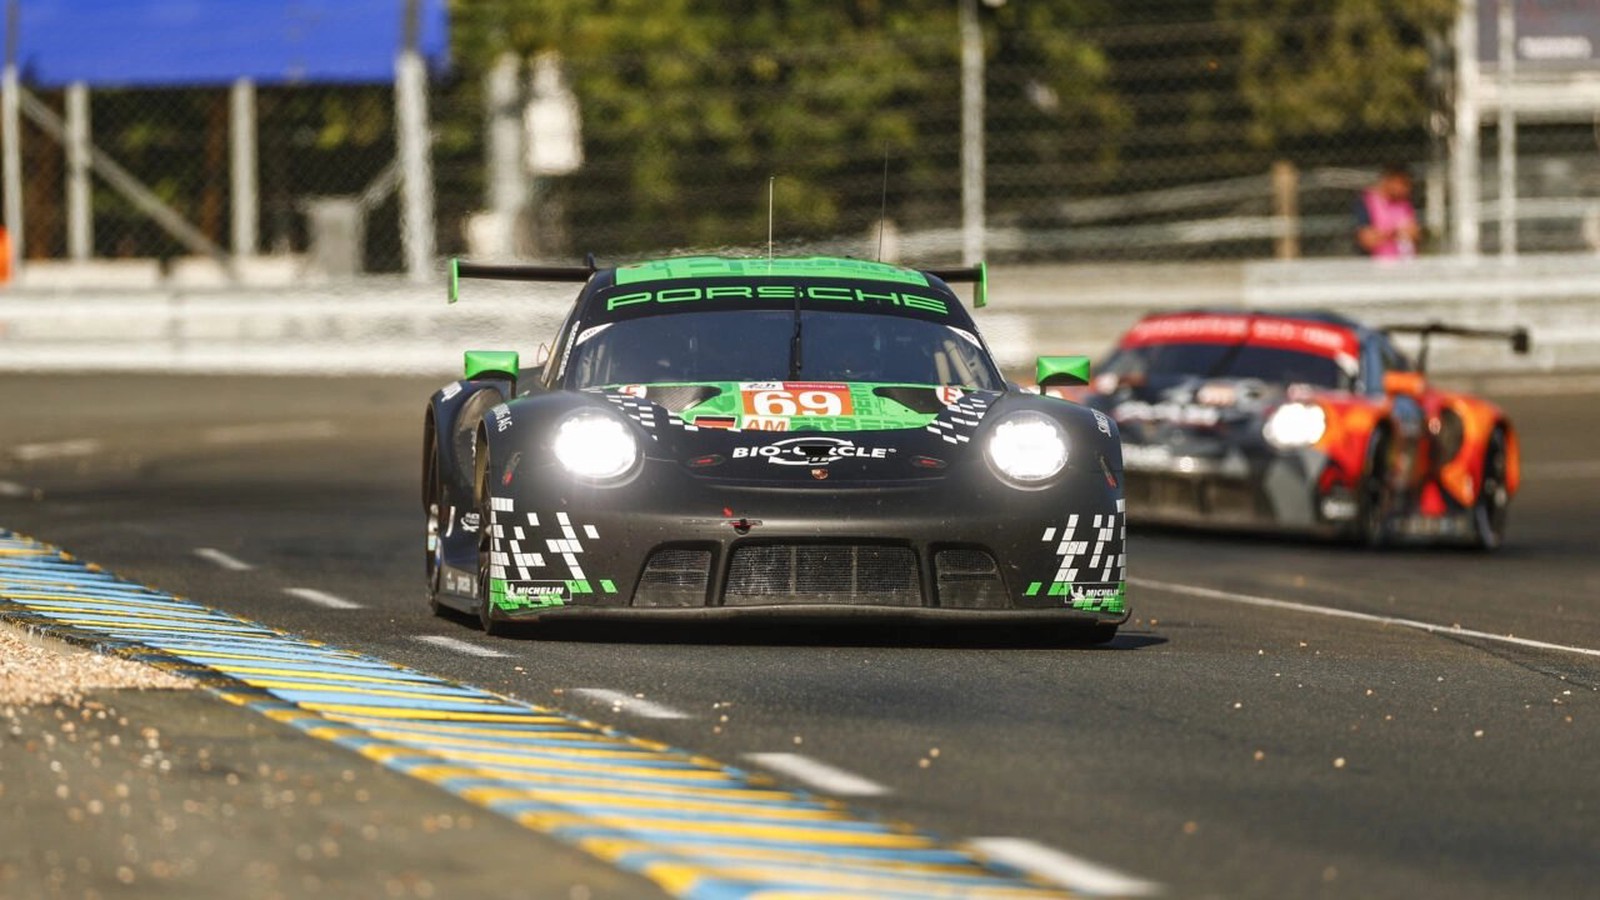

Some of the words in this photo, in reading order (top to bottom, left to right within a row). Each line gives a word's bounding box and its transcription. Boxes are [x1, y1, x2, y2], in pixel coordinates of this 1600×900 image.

[607, 286, 949, 315] PORSCHE
[753, 390, 842, 416] 69
[746, 419, 786, 431] AM
[516, 586, 564, 596] MICHELIN
